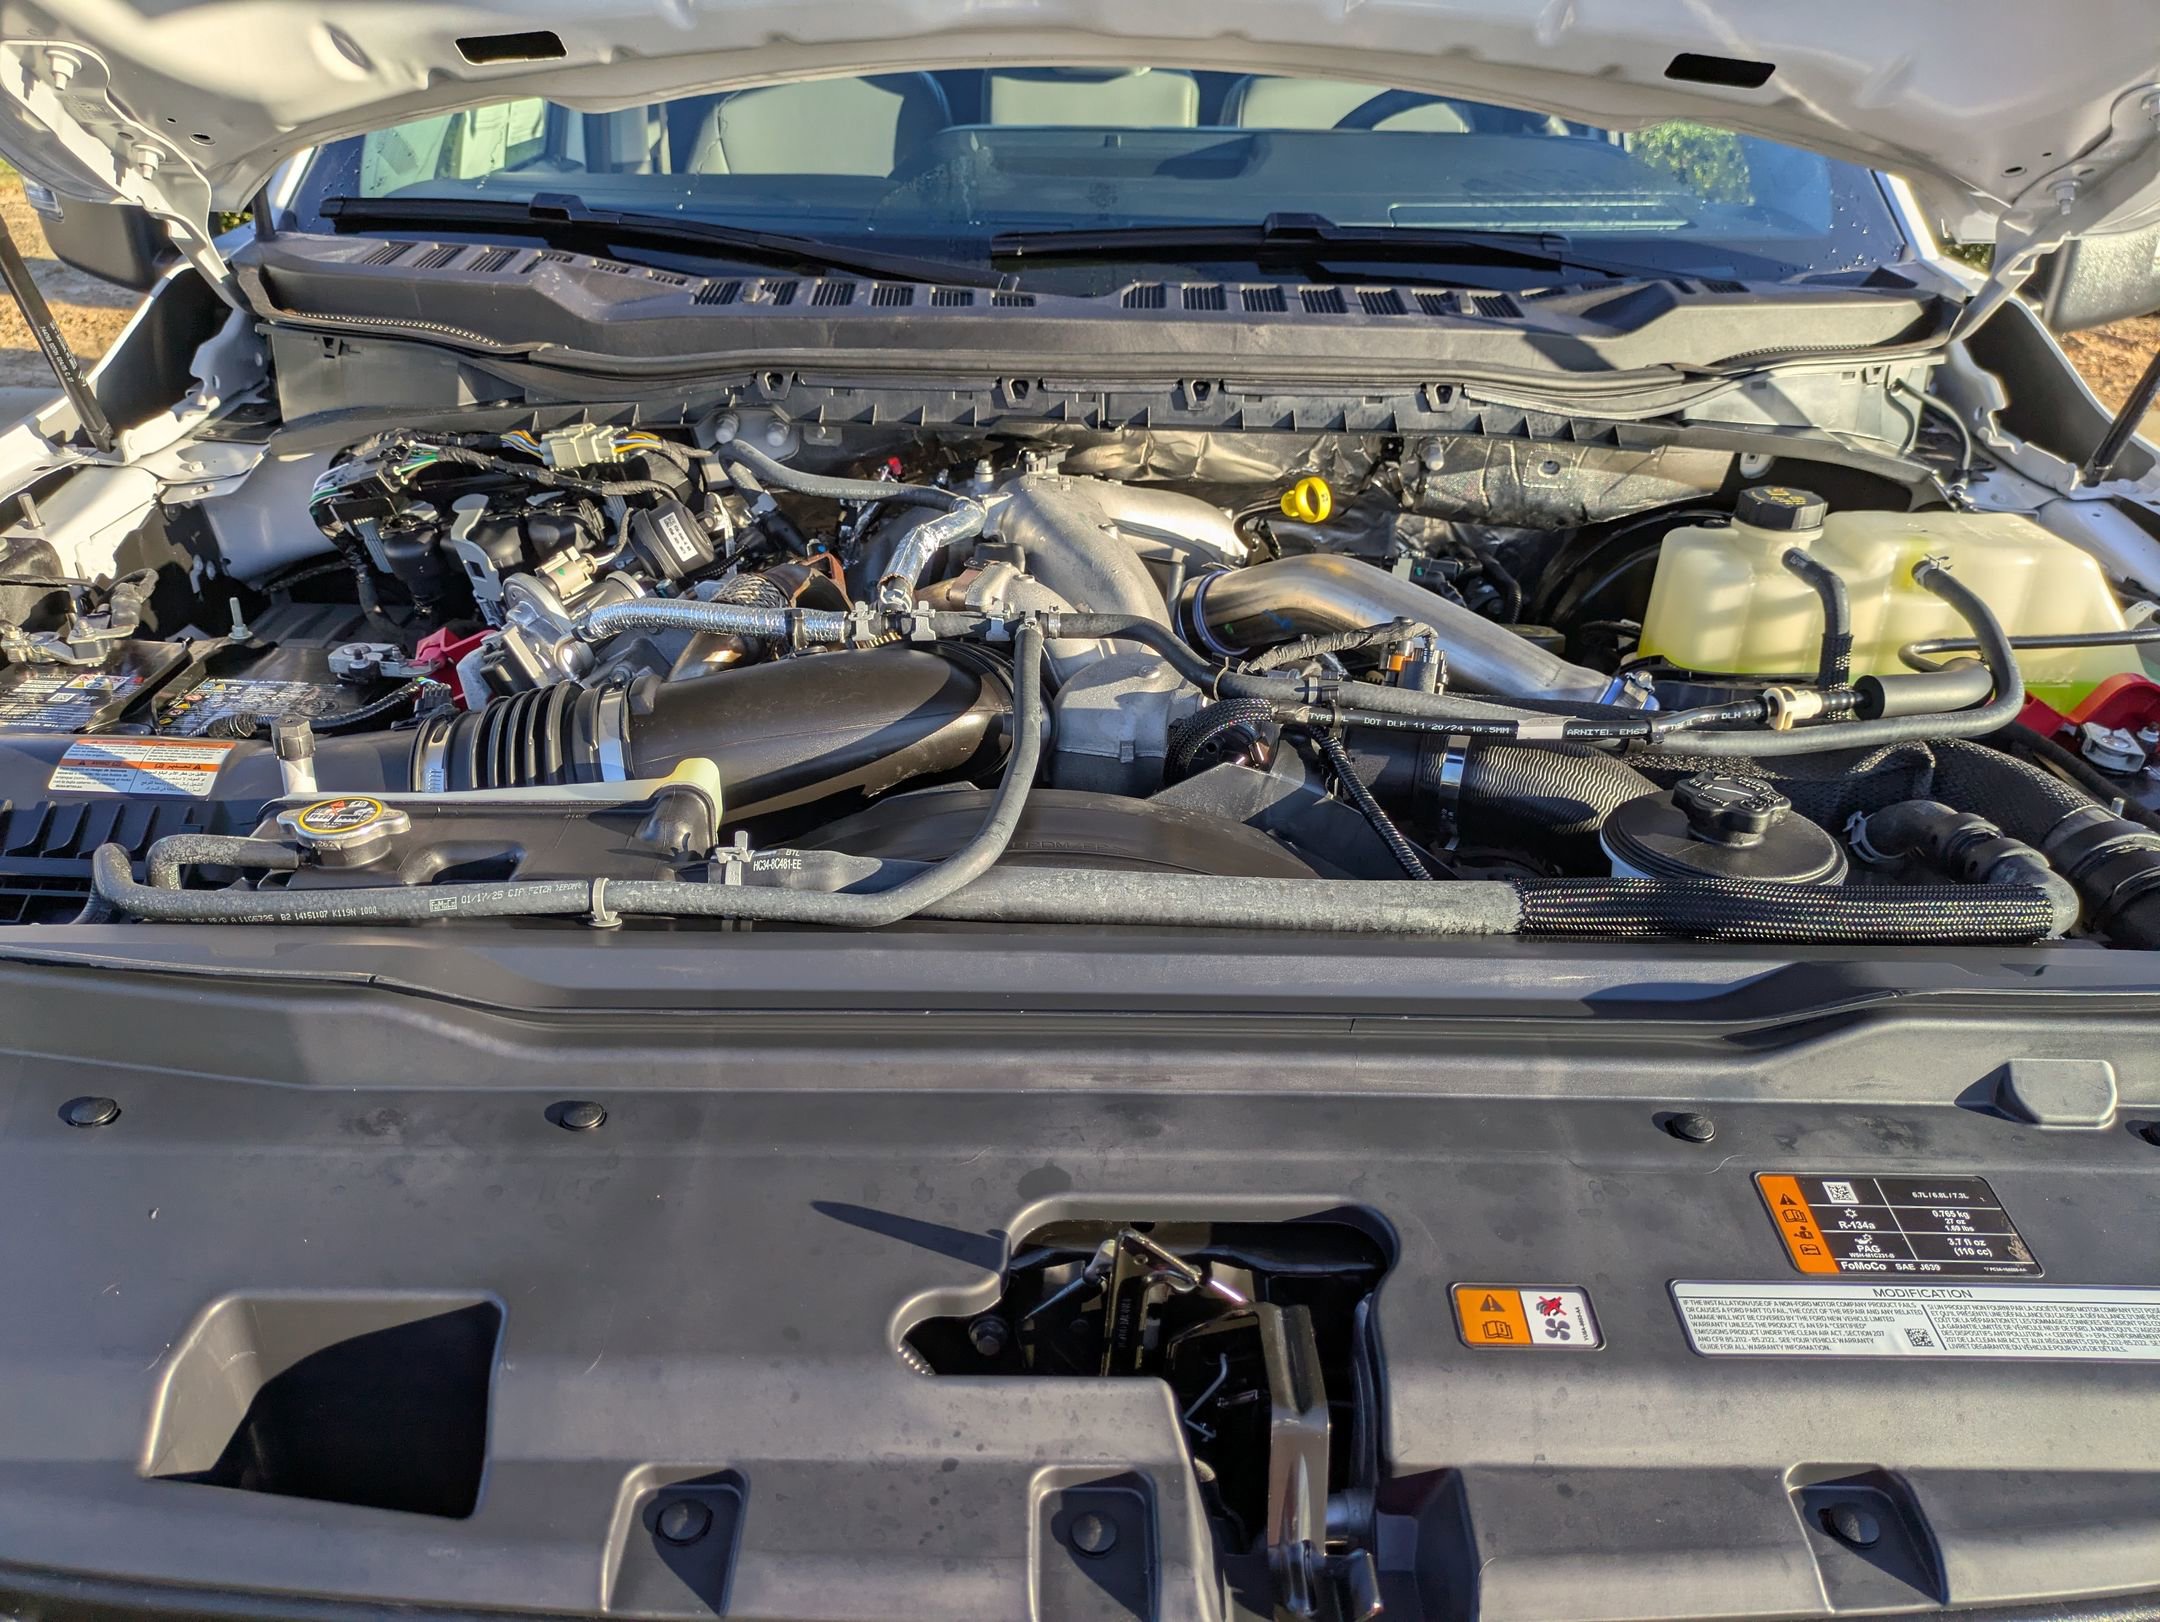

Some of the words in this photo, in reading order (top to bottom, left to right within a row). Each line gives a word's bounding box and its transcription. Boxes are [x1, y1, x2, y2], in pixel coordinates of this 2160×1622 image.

[1308, 712, 1332, 722] TYPE
[1363, 717, 1381, 725] DOT
[1386, 719, 1406, 727] DLH
[1720, 711, 1741, 719] DLH
[460, 890, 503, 904] 01/17/25
[360, 906, 376, 916] 1000
[1932, 1210, 1956, 1218] 0.765
[1956, 1210, 1970, 1220] kg
[1838, 1221, 1876, 1230] R-134a
[1947, 1238, 1962, 1246] 3.7
[1857, 1245, 1880, 1253] PAG
[1954, 1248, 1974, 1256] (110
[1975, 1248, 1993, 1257] cc)
[1841, 1262, 1887, 1271] FoMoCo
[1872, 1288, 1973, 1298] MODIFICATION
